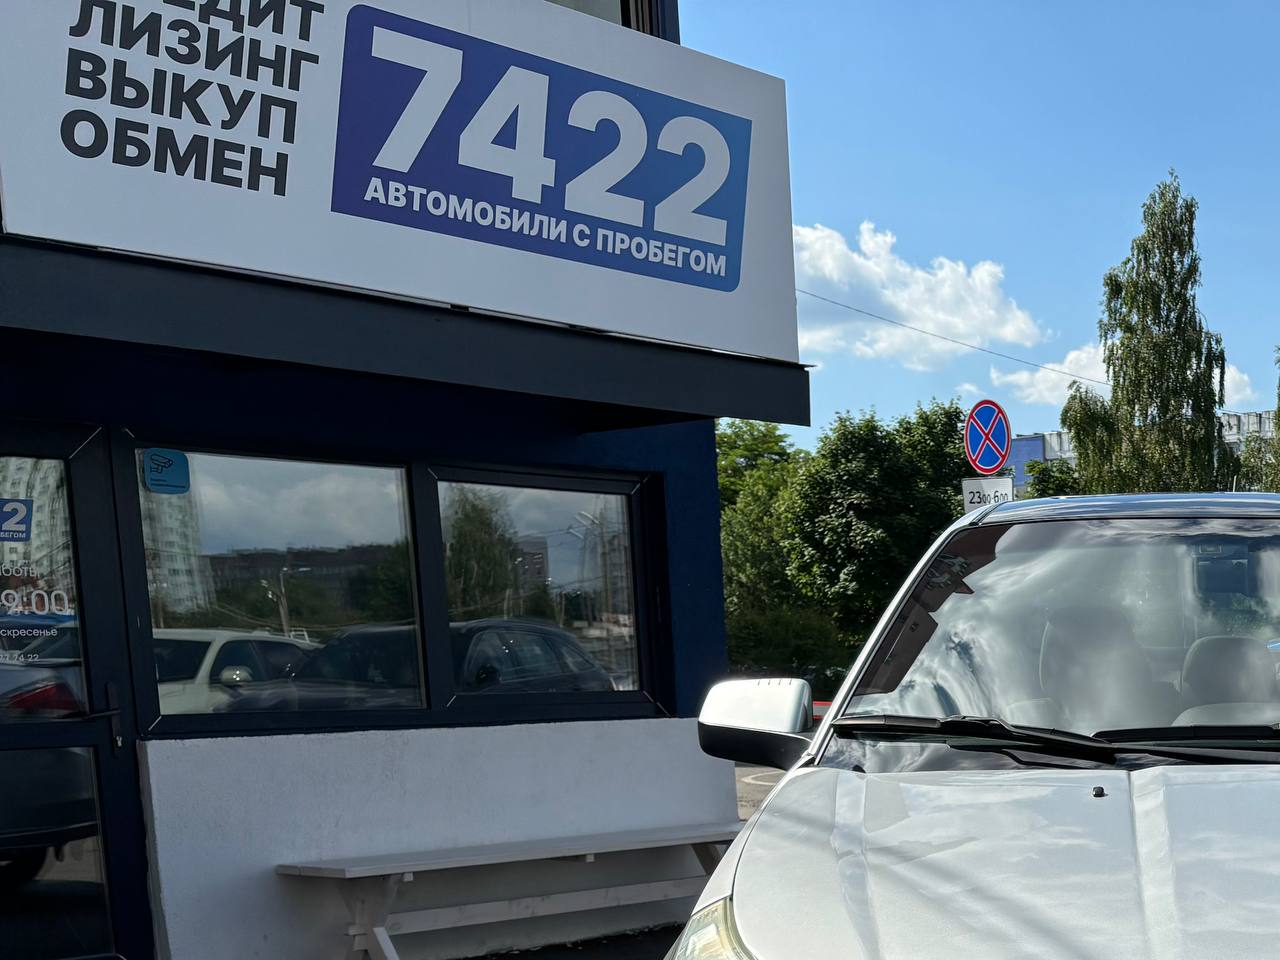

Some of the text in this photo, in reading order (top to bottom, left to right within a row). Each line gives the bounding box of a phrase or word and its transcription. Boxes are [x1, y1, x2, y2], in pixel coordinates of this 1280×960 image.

[69, 0, 319, 91] ЛИЗИНГ
[65, 48, 297, 144] ВЫКУП
[371, 26, 731, 246] 7422
[60, 109, 289, 197] ОБМЕН
[364, 177, 727, 277] АВТОМОБИЛИ С ПРОБЕГОМ
